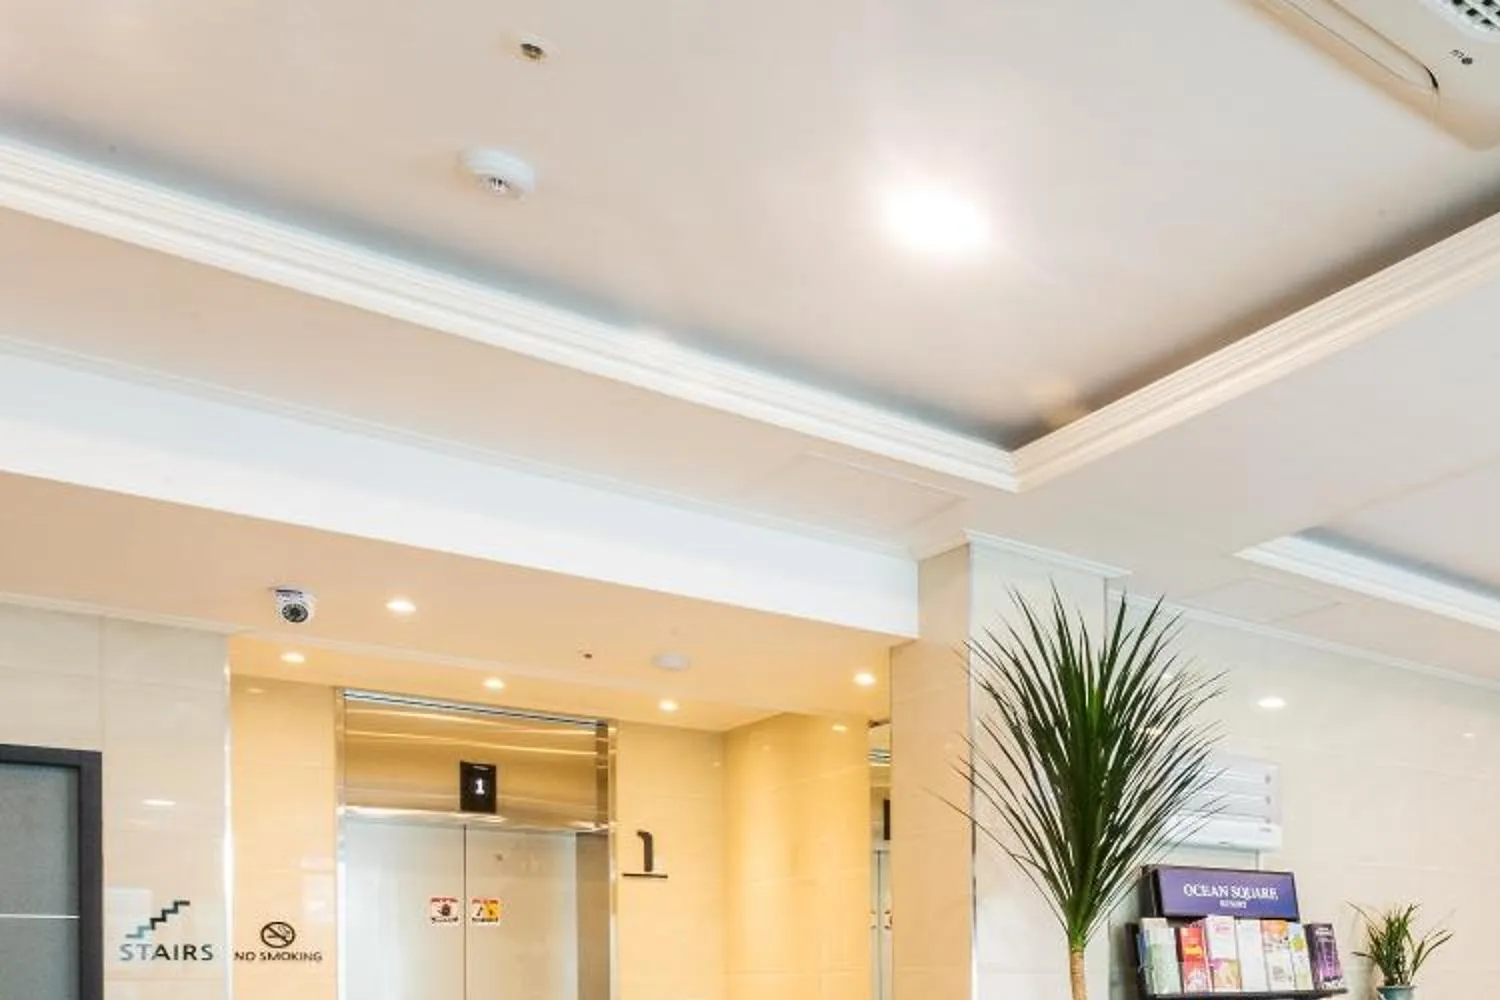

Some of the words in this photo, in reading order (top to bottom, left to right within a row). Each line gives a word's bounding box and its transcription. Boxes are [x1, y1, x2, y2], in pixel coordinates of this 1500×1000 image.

[474, 777, 486, 795] 1
[1183, 883, 1229, 897] OCEAN
[1231, 886, 1277, 901] SQUARE
[119, 943, 214, 962] STAIRS
[234, 951, 256, 963] NO
[259, 951, 323, 963] SMOKING
